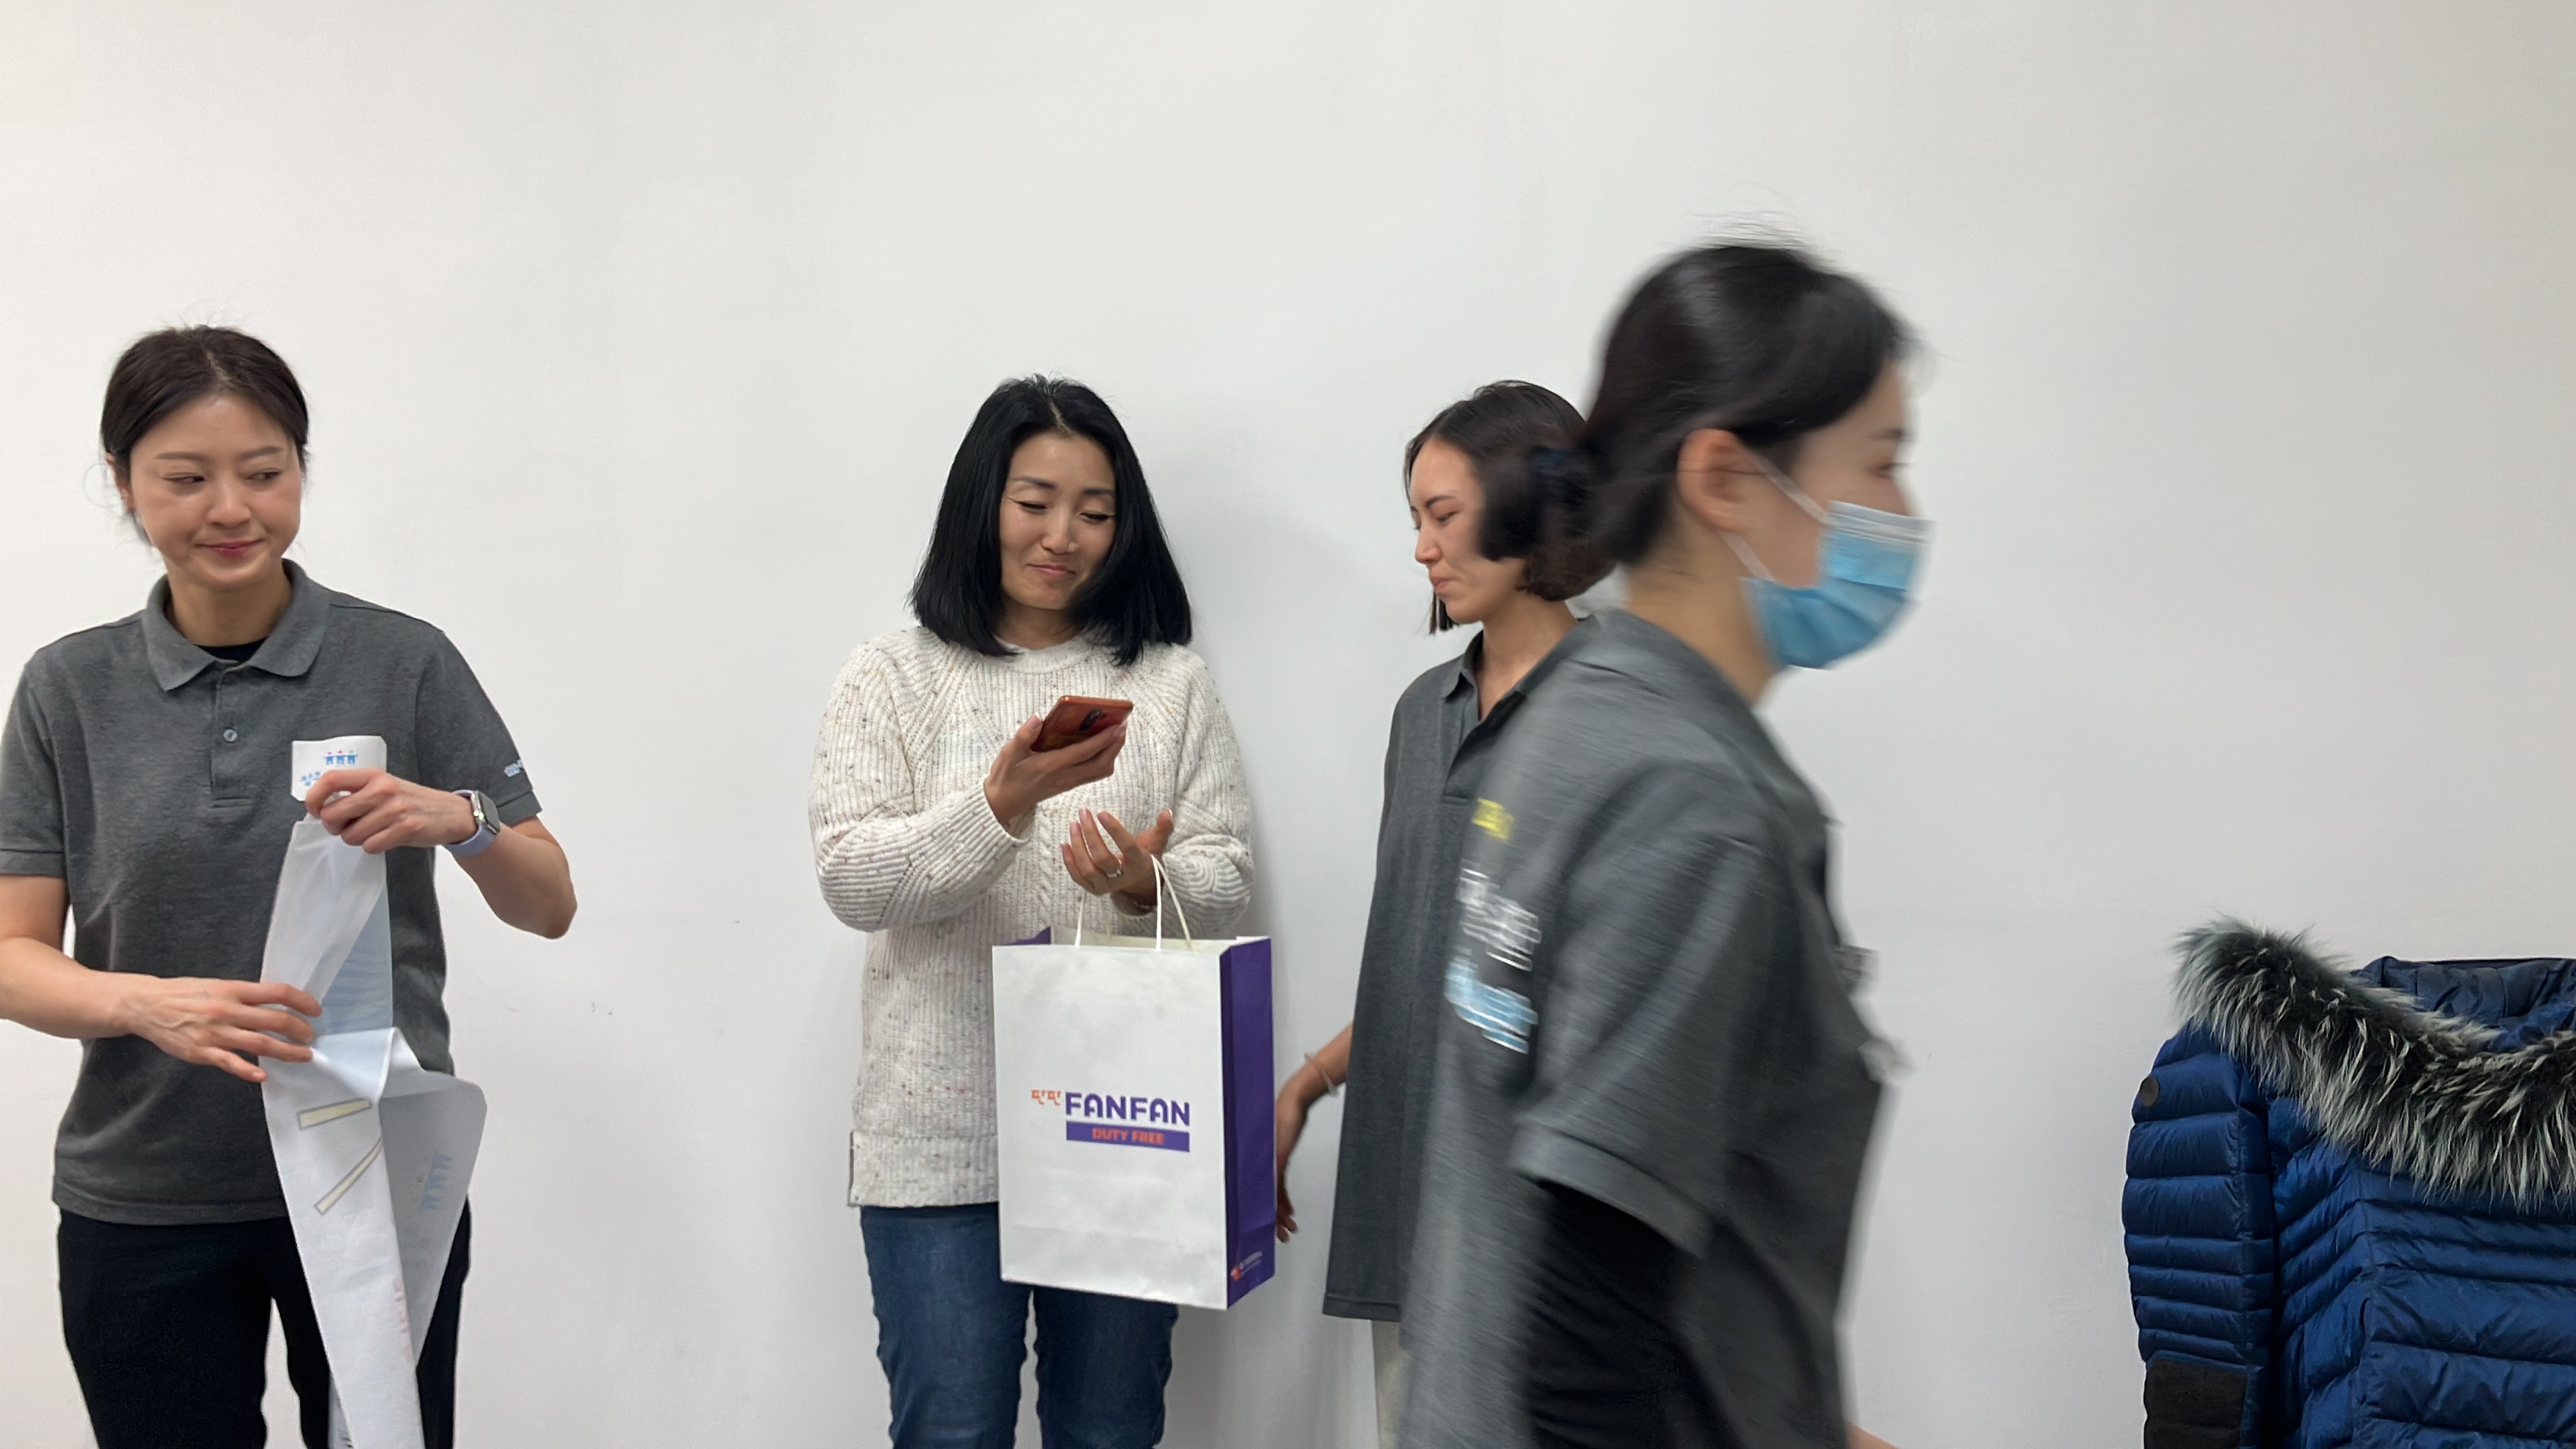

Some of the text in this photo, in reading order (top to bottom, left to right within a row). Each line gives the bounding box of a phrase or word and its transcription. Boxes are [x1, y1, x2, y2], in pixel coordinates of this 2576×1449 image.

[1066, 1092, 1190, 1126] FANFAN
[1093, 1128, 1164, 1145] DUTY FREE
